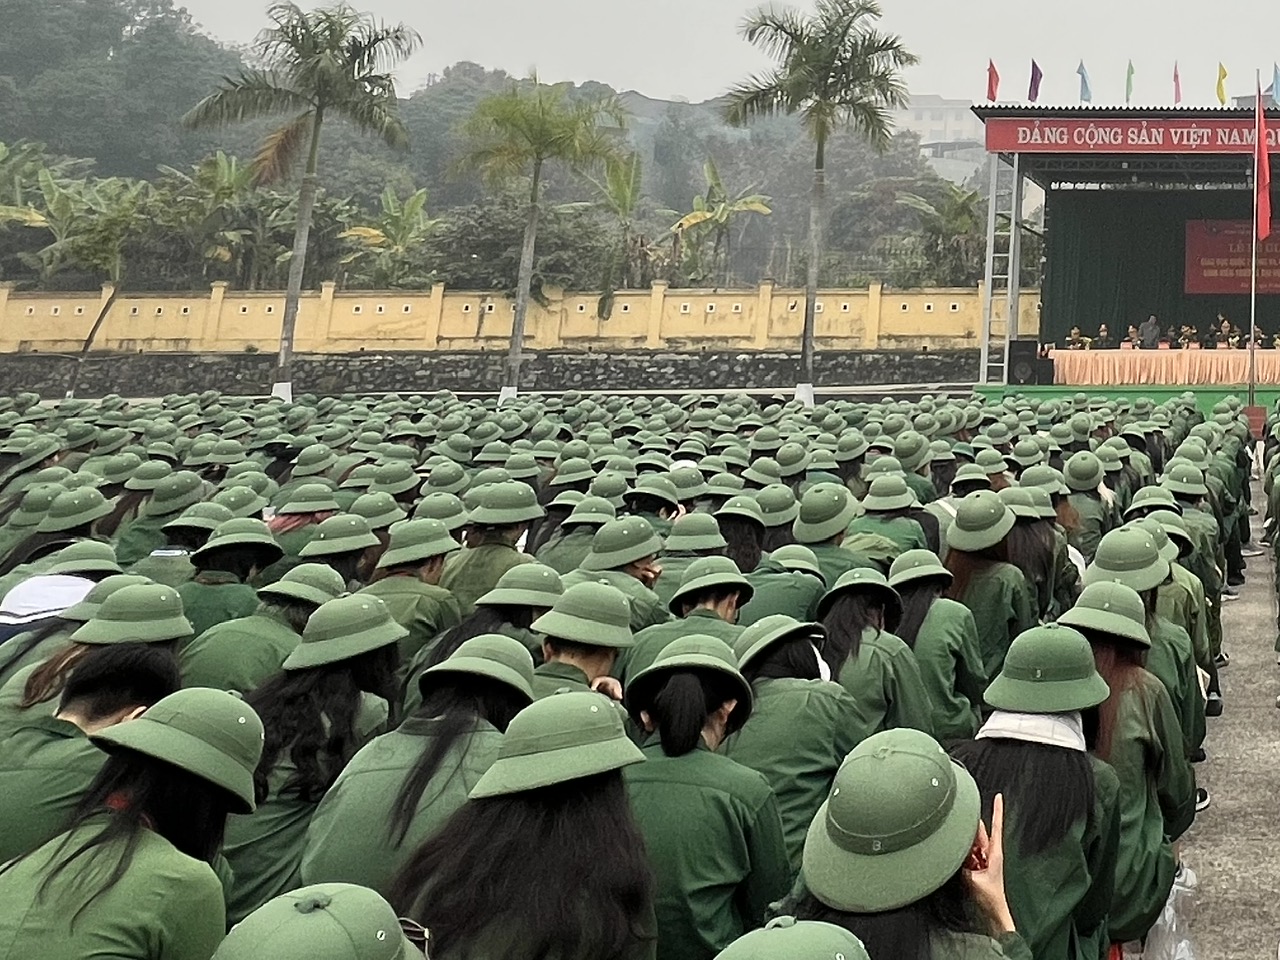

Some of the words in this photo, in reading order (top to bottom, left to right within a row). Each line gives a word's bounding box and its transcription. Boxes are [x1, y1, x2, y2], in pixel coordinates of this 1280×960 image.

[1017, 120, 1070, 144] ĐẢNG
[1073, 122, 1123, 149] CỘNG
[1127, 120, 1165, 145] SẢN
[1169, 122, 1212, 149] VIỆT
[1215, 128, 1256, 145] NAM
